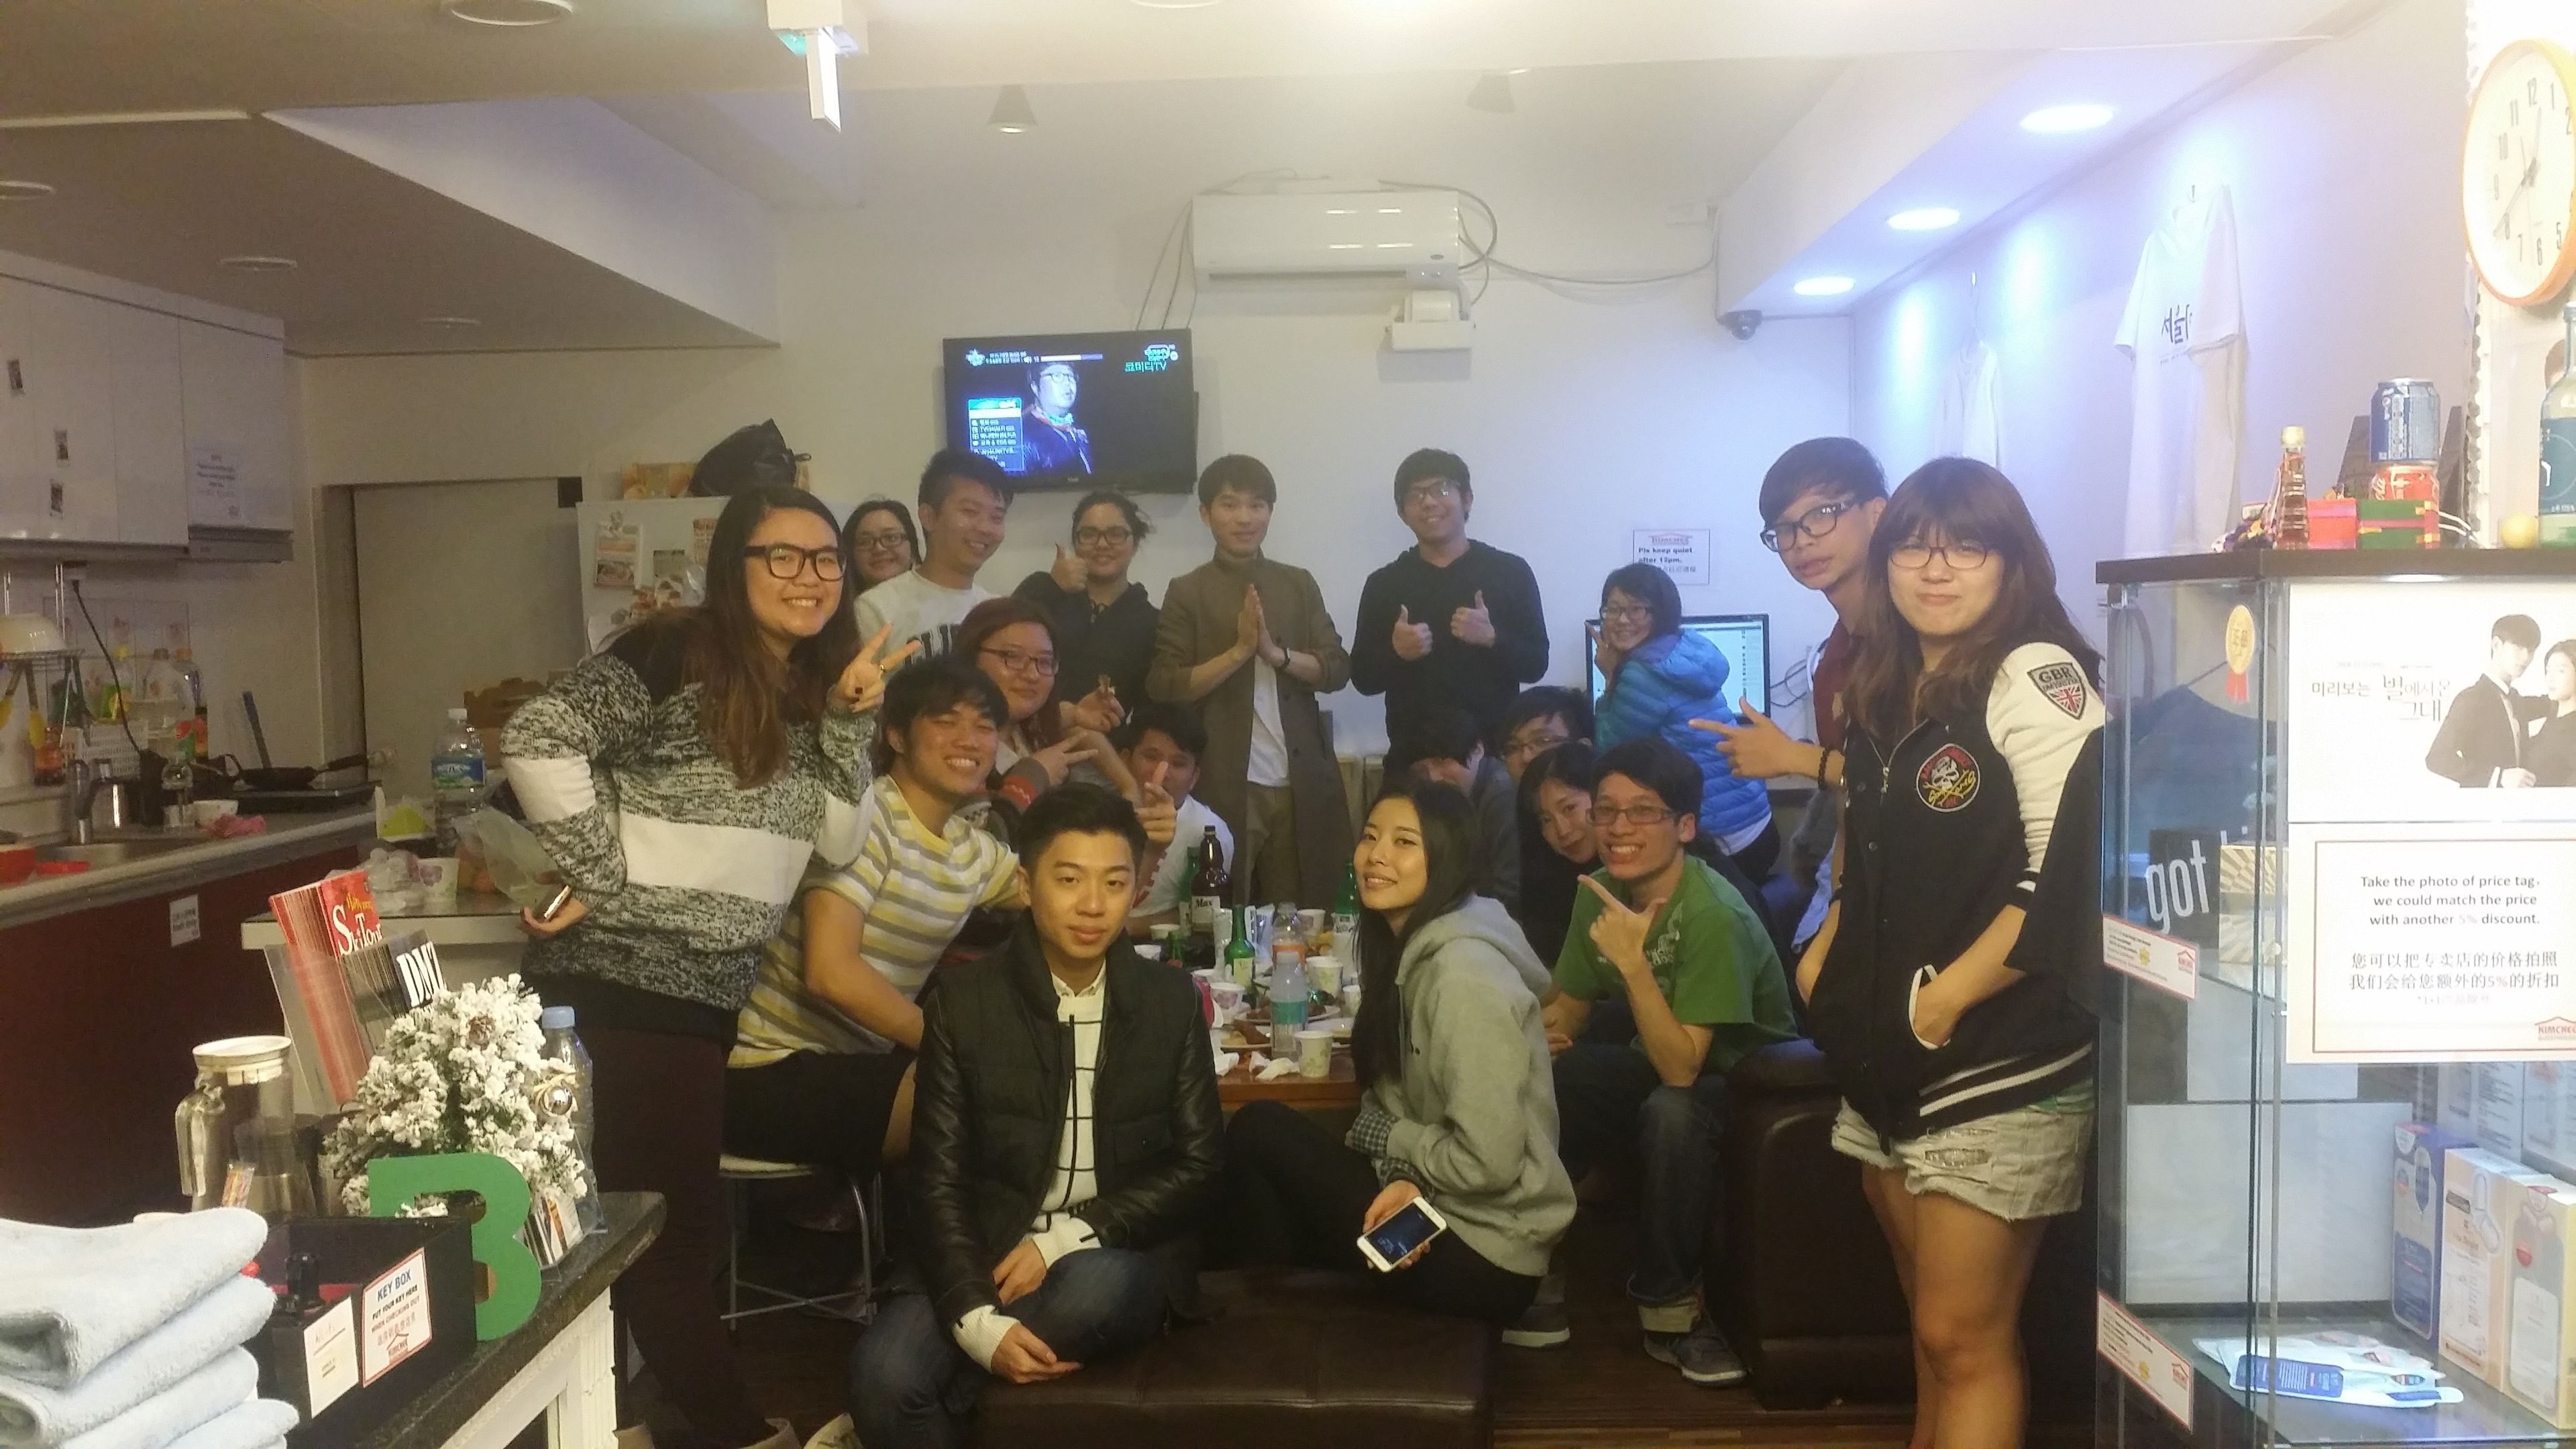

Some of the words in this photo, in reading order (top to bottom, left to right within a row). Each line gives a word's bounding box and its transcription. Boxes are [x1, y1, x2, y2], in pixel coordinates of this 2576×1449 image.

[2527, 77, 2537, 107] 12
[2550, 83, 2555, 110] 1
[2565, 107, 2572, 136] 2
[2518, 234, 2522, 262] 7
[2557, 221, 2562, 250] 5
[2536, 237, 2542, 266] 6
[2039, 667, 2072, 683] GBR
[2312, 681, 2371, 697] 미리보는
[2400, 699, 2440, 722] 그대
[2145, 839, 2210, 934] got
[2361, 875, 2390, 888] Take
[2394, 875, 2415, 887] the
[2420, 875, 2458, 889] photo
[2463, 875, 2475, 886] of
[2479, 875, 2511, 889] price
[2373, 898, 2392, 906] we
[2397, 894, 2432, 906] could
[2436, 894, 2476, 905] match
[2481, 894, 2501, 905] the
[2506, 894, 2537, 907] price
[2369, 914, 2398, 925] with
[2403, 914, 2453, 925] another
[2459, 914, 2477, 924] 5%
[2481, 913, 2540, 924] discount.
[377, 1281, 393, 1303] KEY
[395, 1269, 411, 1290] BOX
[372, 1310, 382, 1321] PUT
[382, 1299, 394, 1313] YOUR
[395, 1293, 405, 1305] KEY
[406, 1284, 418, 1297] HERE
[386, 1303, 410, 1324] CHECKING
[410, 1295, 420, 1307] OUT
